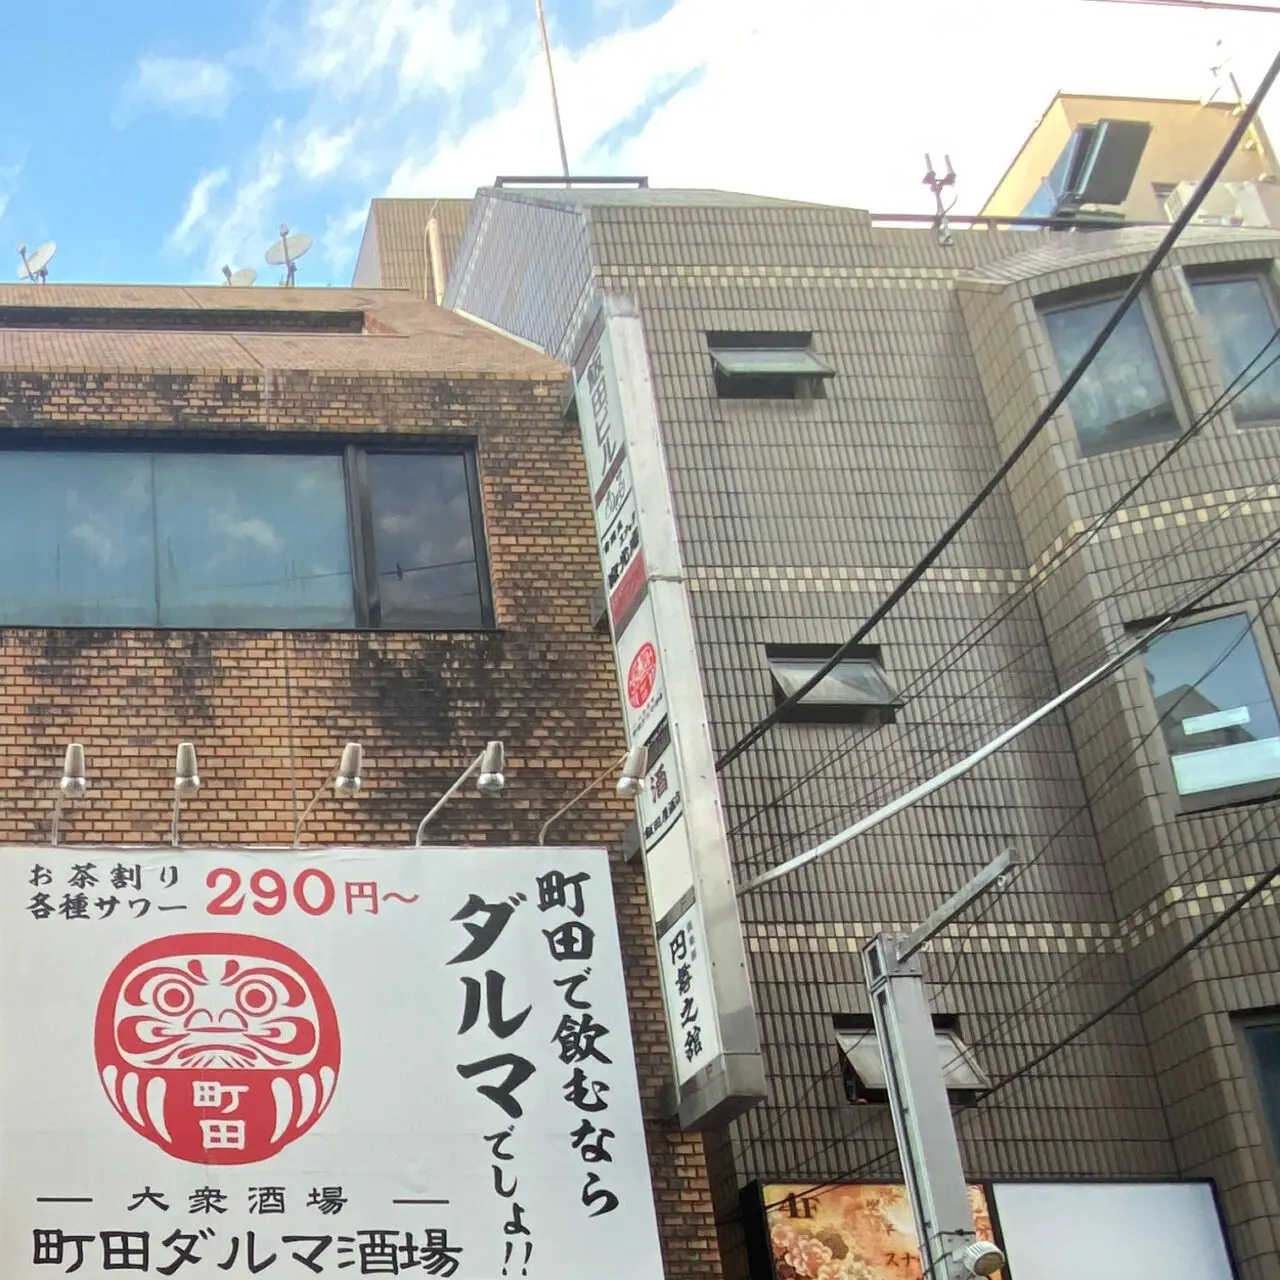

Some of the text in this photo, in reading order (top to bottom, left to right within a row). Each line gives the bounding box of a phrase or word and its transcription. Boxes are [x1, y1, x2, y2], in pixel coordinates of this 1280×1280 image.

[650, 763, 669, 804] 酒
[28, 863, 180, 890] お茶割り
[25, 891, 188, 920] 各種サワー
[534, 869, 620, 1219] 町田で飲むなら
[191, 1080, 251, 1152] 町田
[126, 1186, 348, 1215] 大衆酒場
[778, 1193, 820, 1218] 4F
[32, 1227, 463, 1279] 町田ダルマ酒場
[884, 1252, 921, 1266] スナ
